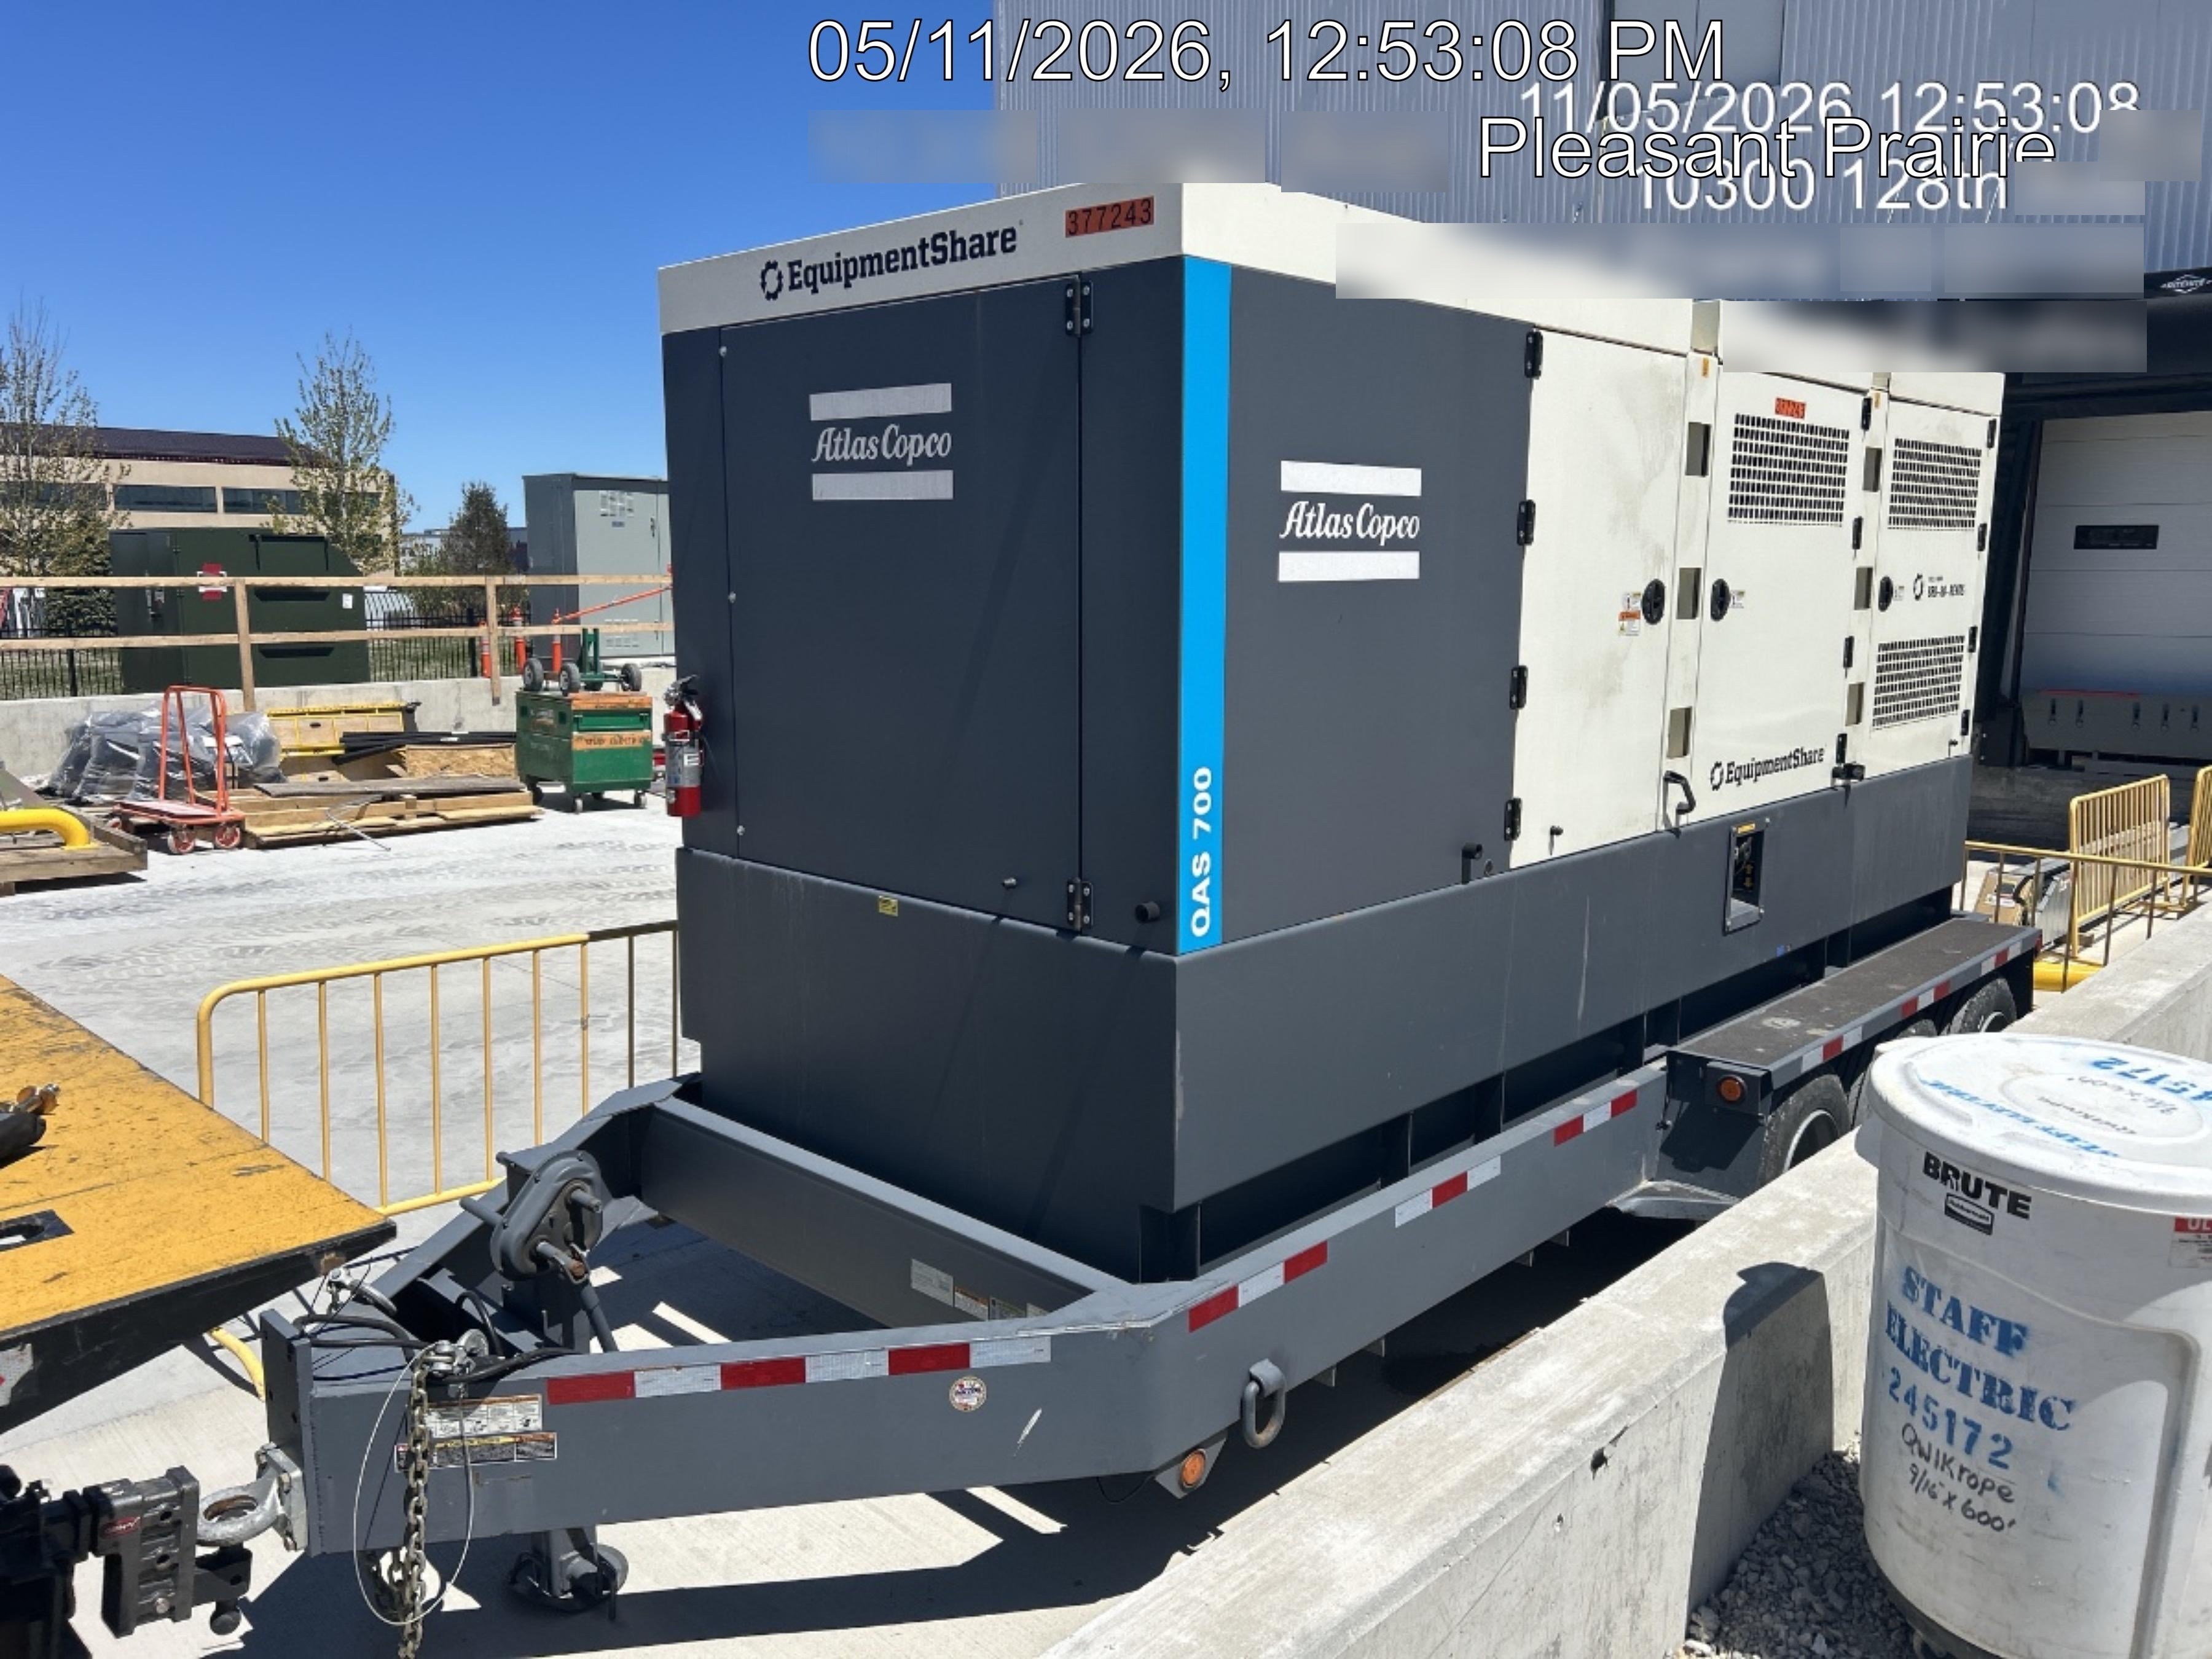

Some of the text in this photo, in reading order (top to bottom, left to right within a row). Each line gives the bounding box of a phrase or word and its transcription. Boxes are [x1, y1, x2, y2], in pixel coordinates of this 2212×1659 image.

[1068, 198, 1151, 236] 377243
[788, 226, 1018, 294] EquipmentShare
[811, 423, 952, 467] Atlas Copco
[1279, 500, 1420, 546] Atlas Copco
[1725, 746, 1824, 787] EquipmentShare
[1191, 766, 1212, 937] QAS 700
[1923, 1151, 2031, 1220] BRUTE
[1902, 1266, 2030, 1357] STAFF
[1885, 1299, 2075, 1431] ELECTRIC
[1889, 1366, 2013, 1470] 245172
